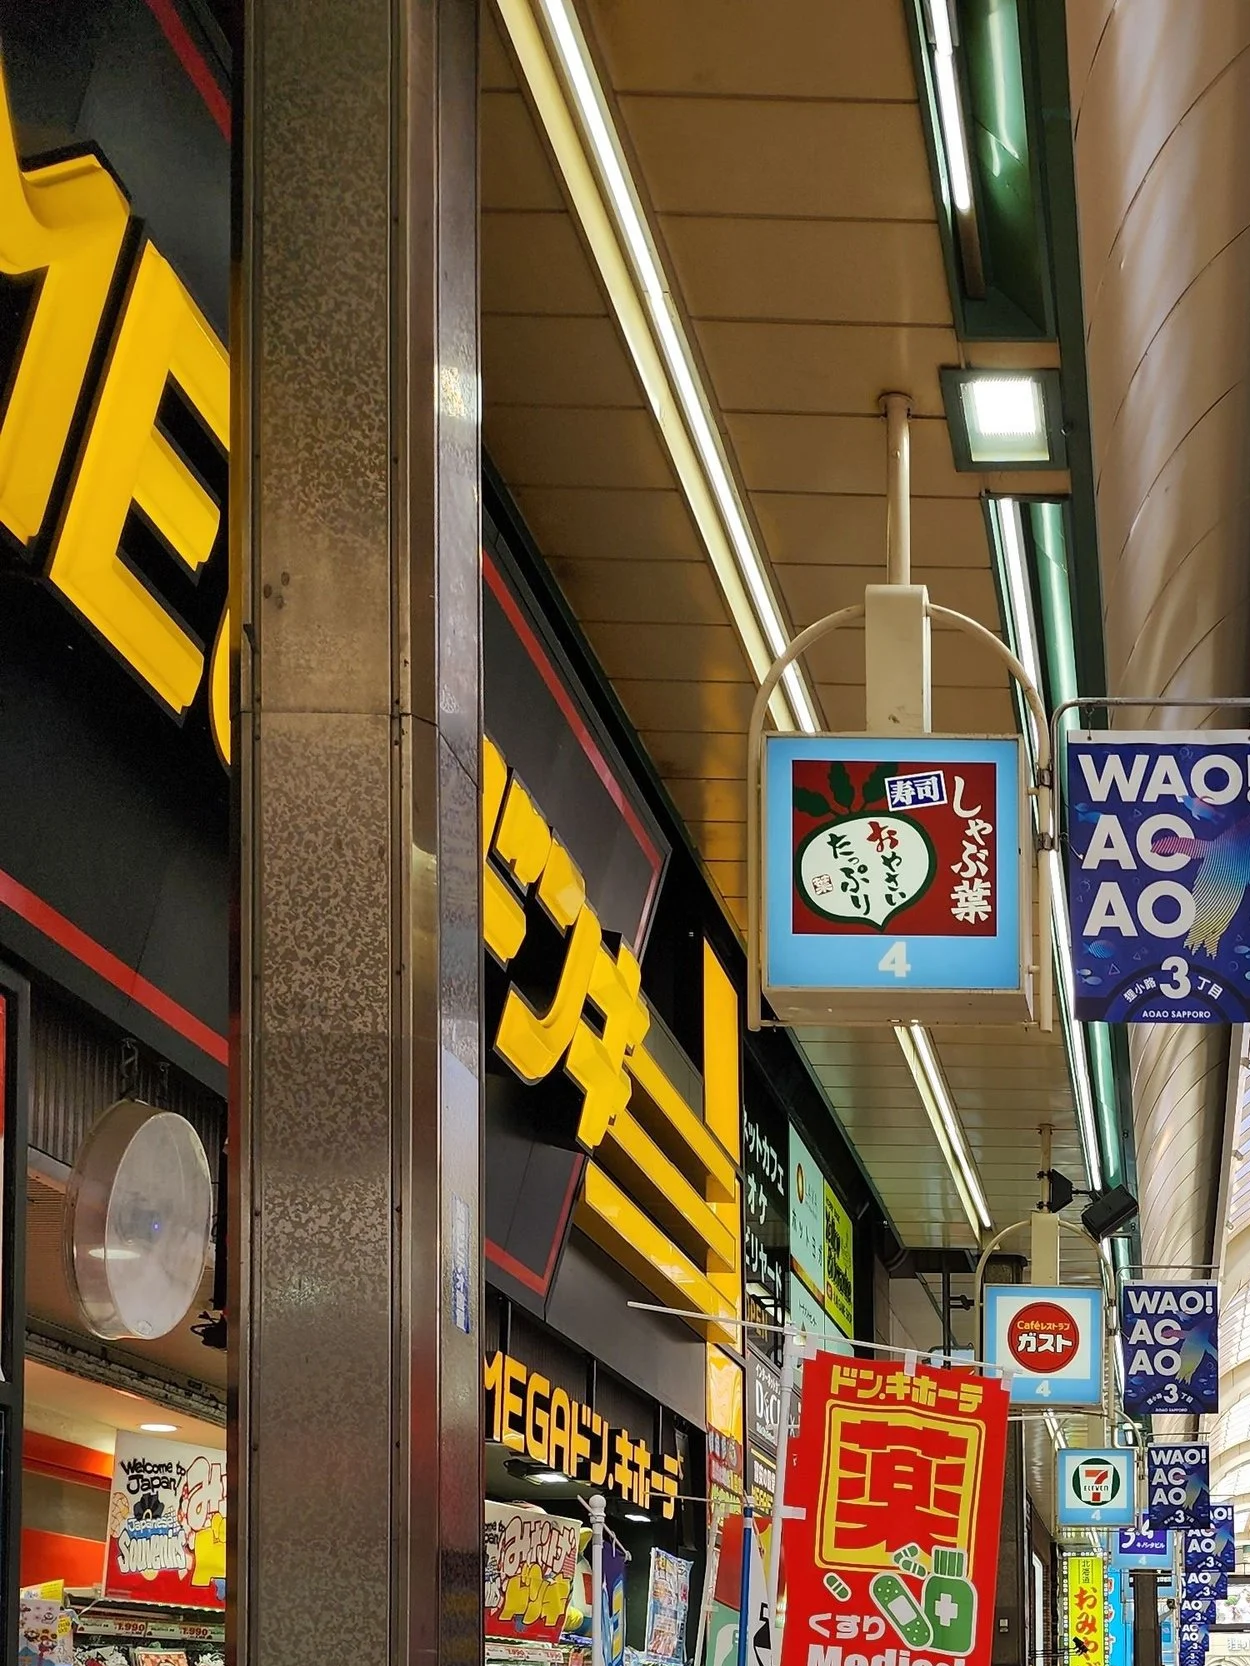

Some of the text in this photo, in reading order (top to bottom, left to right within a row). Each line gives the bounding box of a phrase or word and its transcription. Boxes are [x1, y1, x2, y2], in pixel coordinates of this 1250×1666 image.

[890, 776, 940, 806] 寿司
[950, 775, 993, 924] しゃぶ葉
[826, 833, 872, 915] たっぷり
[866, 821, 907, 907] おやさい
[1082, 880, 1197, 939] AO
[878, 941, 911, 978] 4
[1123, 956, 1223, 1003] 狸小路 3 丁目
[1142, 1009, 1211, 1019] AOAO SAPPORO
[1127, 1291, 1214, 1315] WAO!
[1017, 1332, 1073, 1353] ガスト
[1128, 1349, 1182, 1377] AO
[1035, 1379, 1051, 1397] 4
[1164, 1383, 1178, 1404] 3
[120, 1458, 173, 1475] Welcome
[1150, 1449, 1207, 1465] WAO!
[126, 1474, 183, 1496] Japan!
[834, 1420, 970, 1556] 薬
[1085, 1470, 1109, 1502] 7
[1152, 1488, 1187, 1506] AO
[128, 1517, 173, 1531] Japanese
[1091, 1509, 1101, 1520] 4
[1174, 1510, 1186, 1523] 3
[1188, 1538, 1216, 1553] AO
[808, 1612, 886, 1640] くすり
